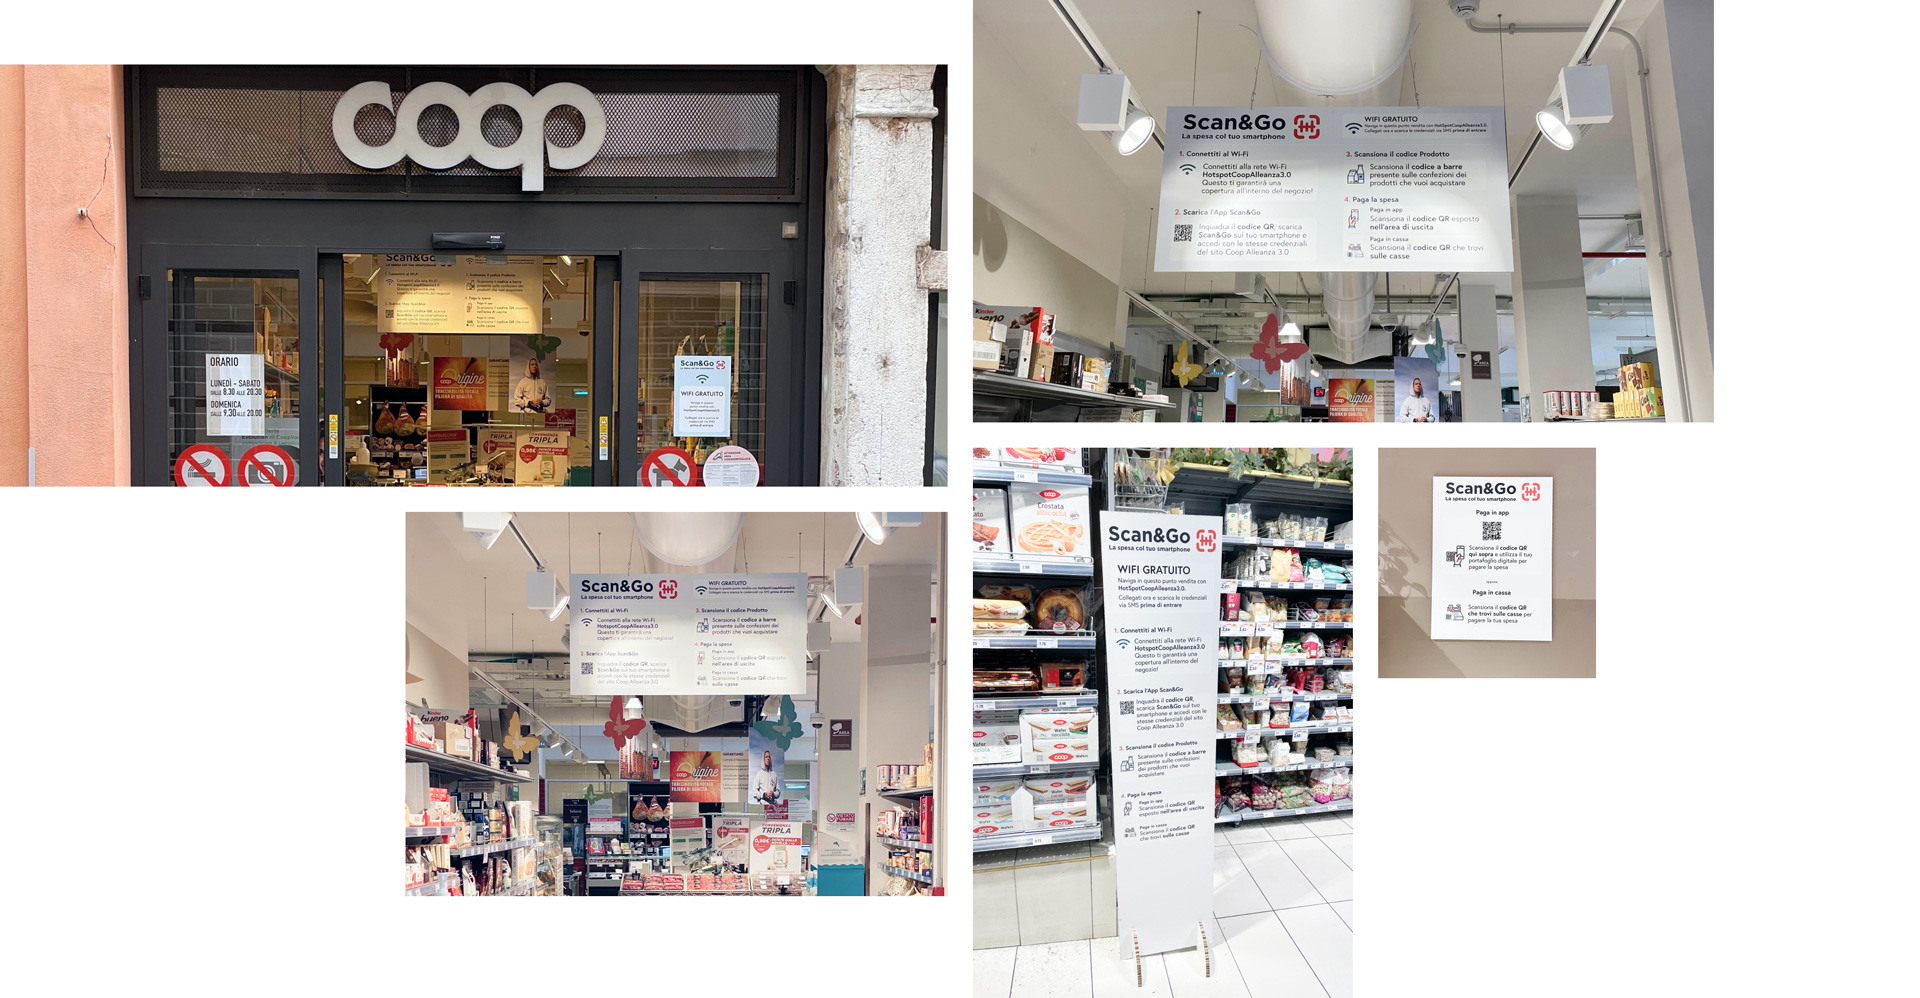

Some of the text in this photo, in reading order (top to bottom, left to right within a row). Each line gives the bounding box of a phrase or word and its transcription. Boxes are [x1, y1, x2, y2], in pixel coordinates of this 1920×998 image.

[1183, 114, 1286, 130] Scan&Go
[332, 80, 606, 191] coop
[210, 357, 238, 366] ORARIO
[210, 378, 232, 387] LUNEDÌ
[1446, 482, 1516, 495] Scan&Go
[1108, 526, 1190, 544] Scan&Go
[1118, 565, 1190, 575] WIFI GRATUITO
[581, 580, 653, 592] Scan&Go
[1134, 644, 1205, 652] HotspotCoopAlleanza3.0
